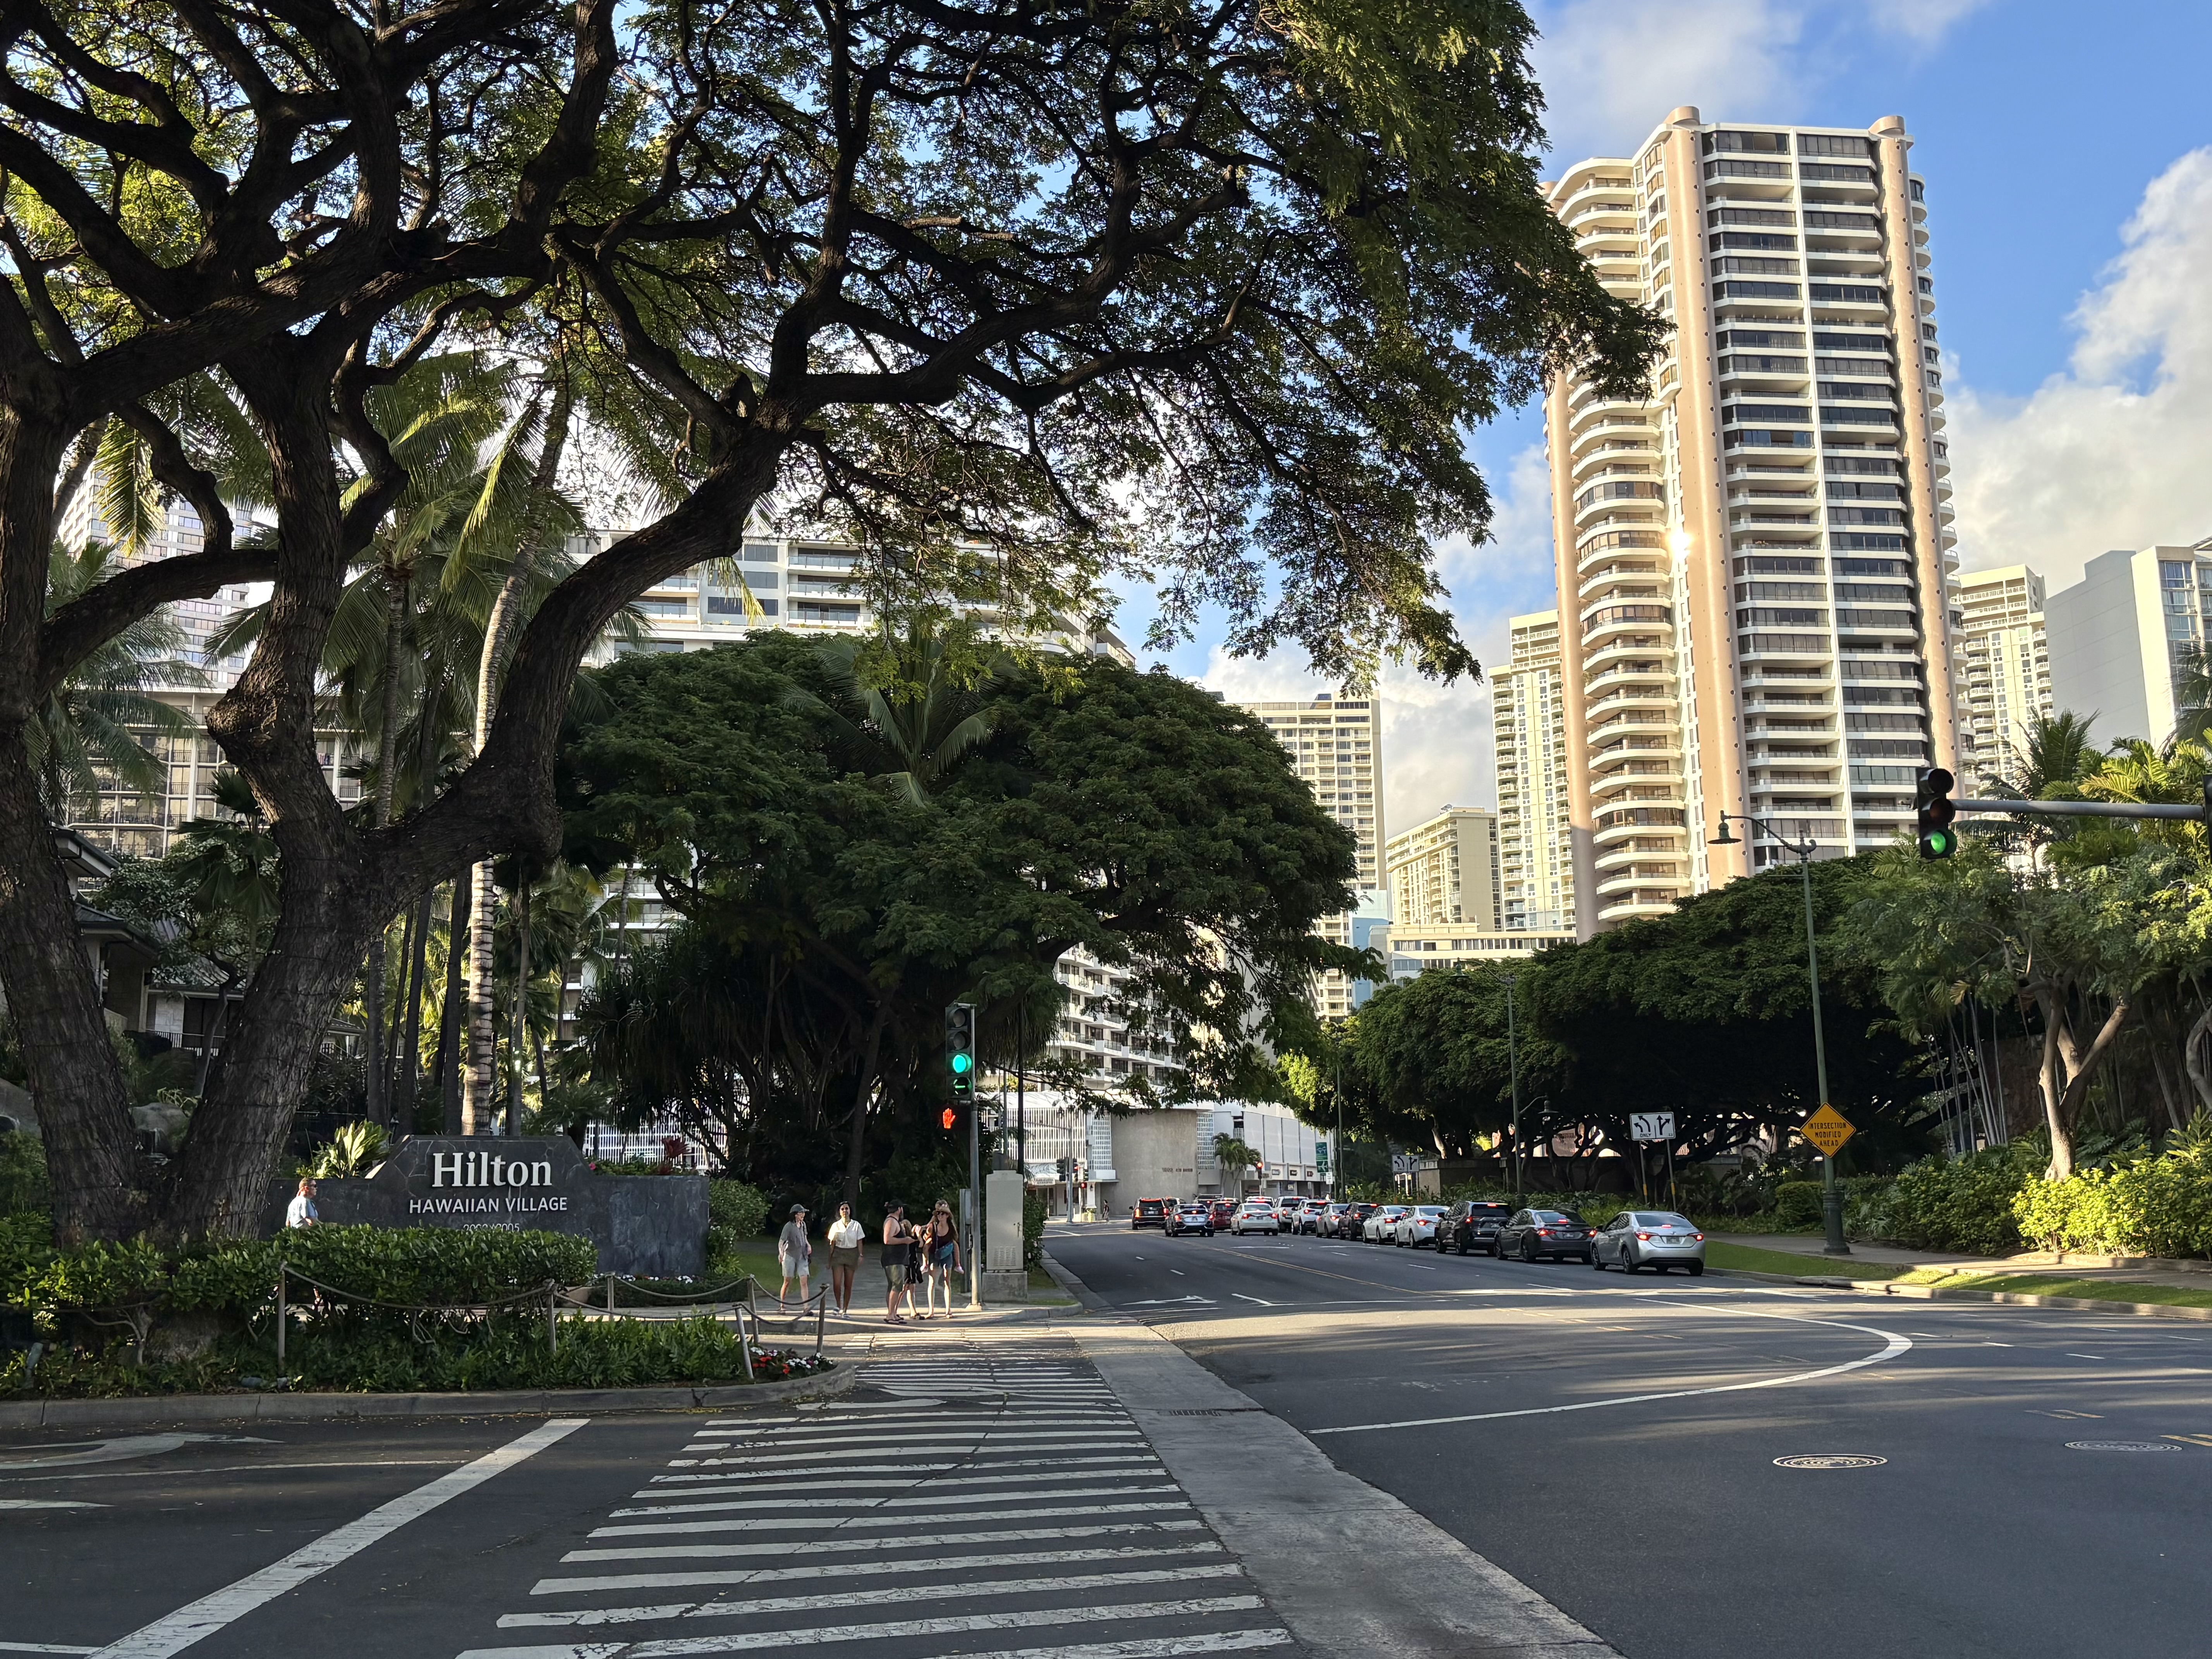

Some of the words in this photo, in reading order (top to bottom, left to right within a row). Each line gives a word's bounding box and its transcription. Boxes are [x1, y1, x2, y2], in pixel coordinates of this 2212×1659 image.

[432, 1151, 552, 1187] Hilton
[409, 1199, 499, 1213] HAWAIIAN
[505, 1197, 567, 1212] VILLAGE
